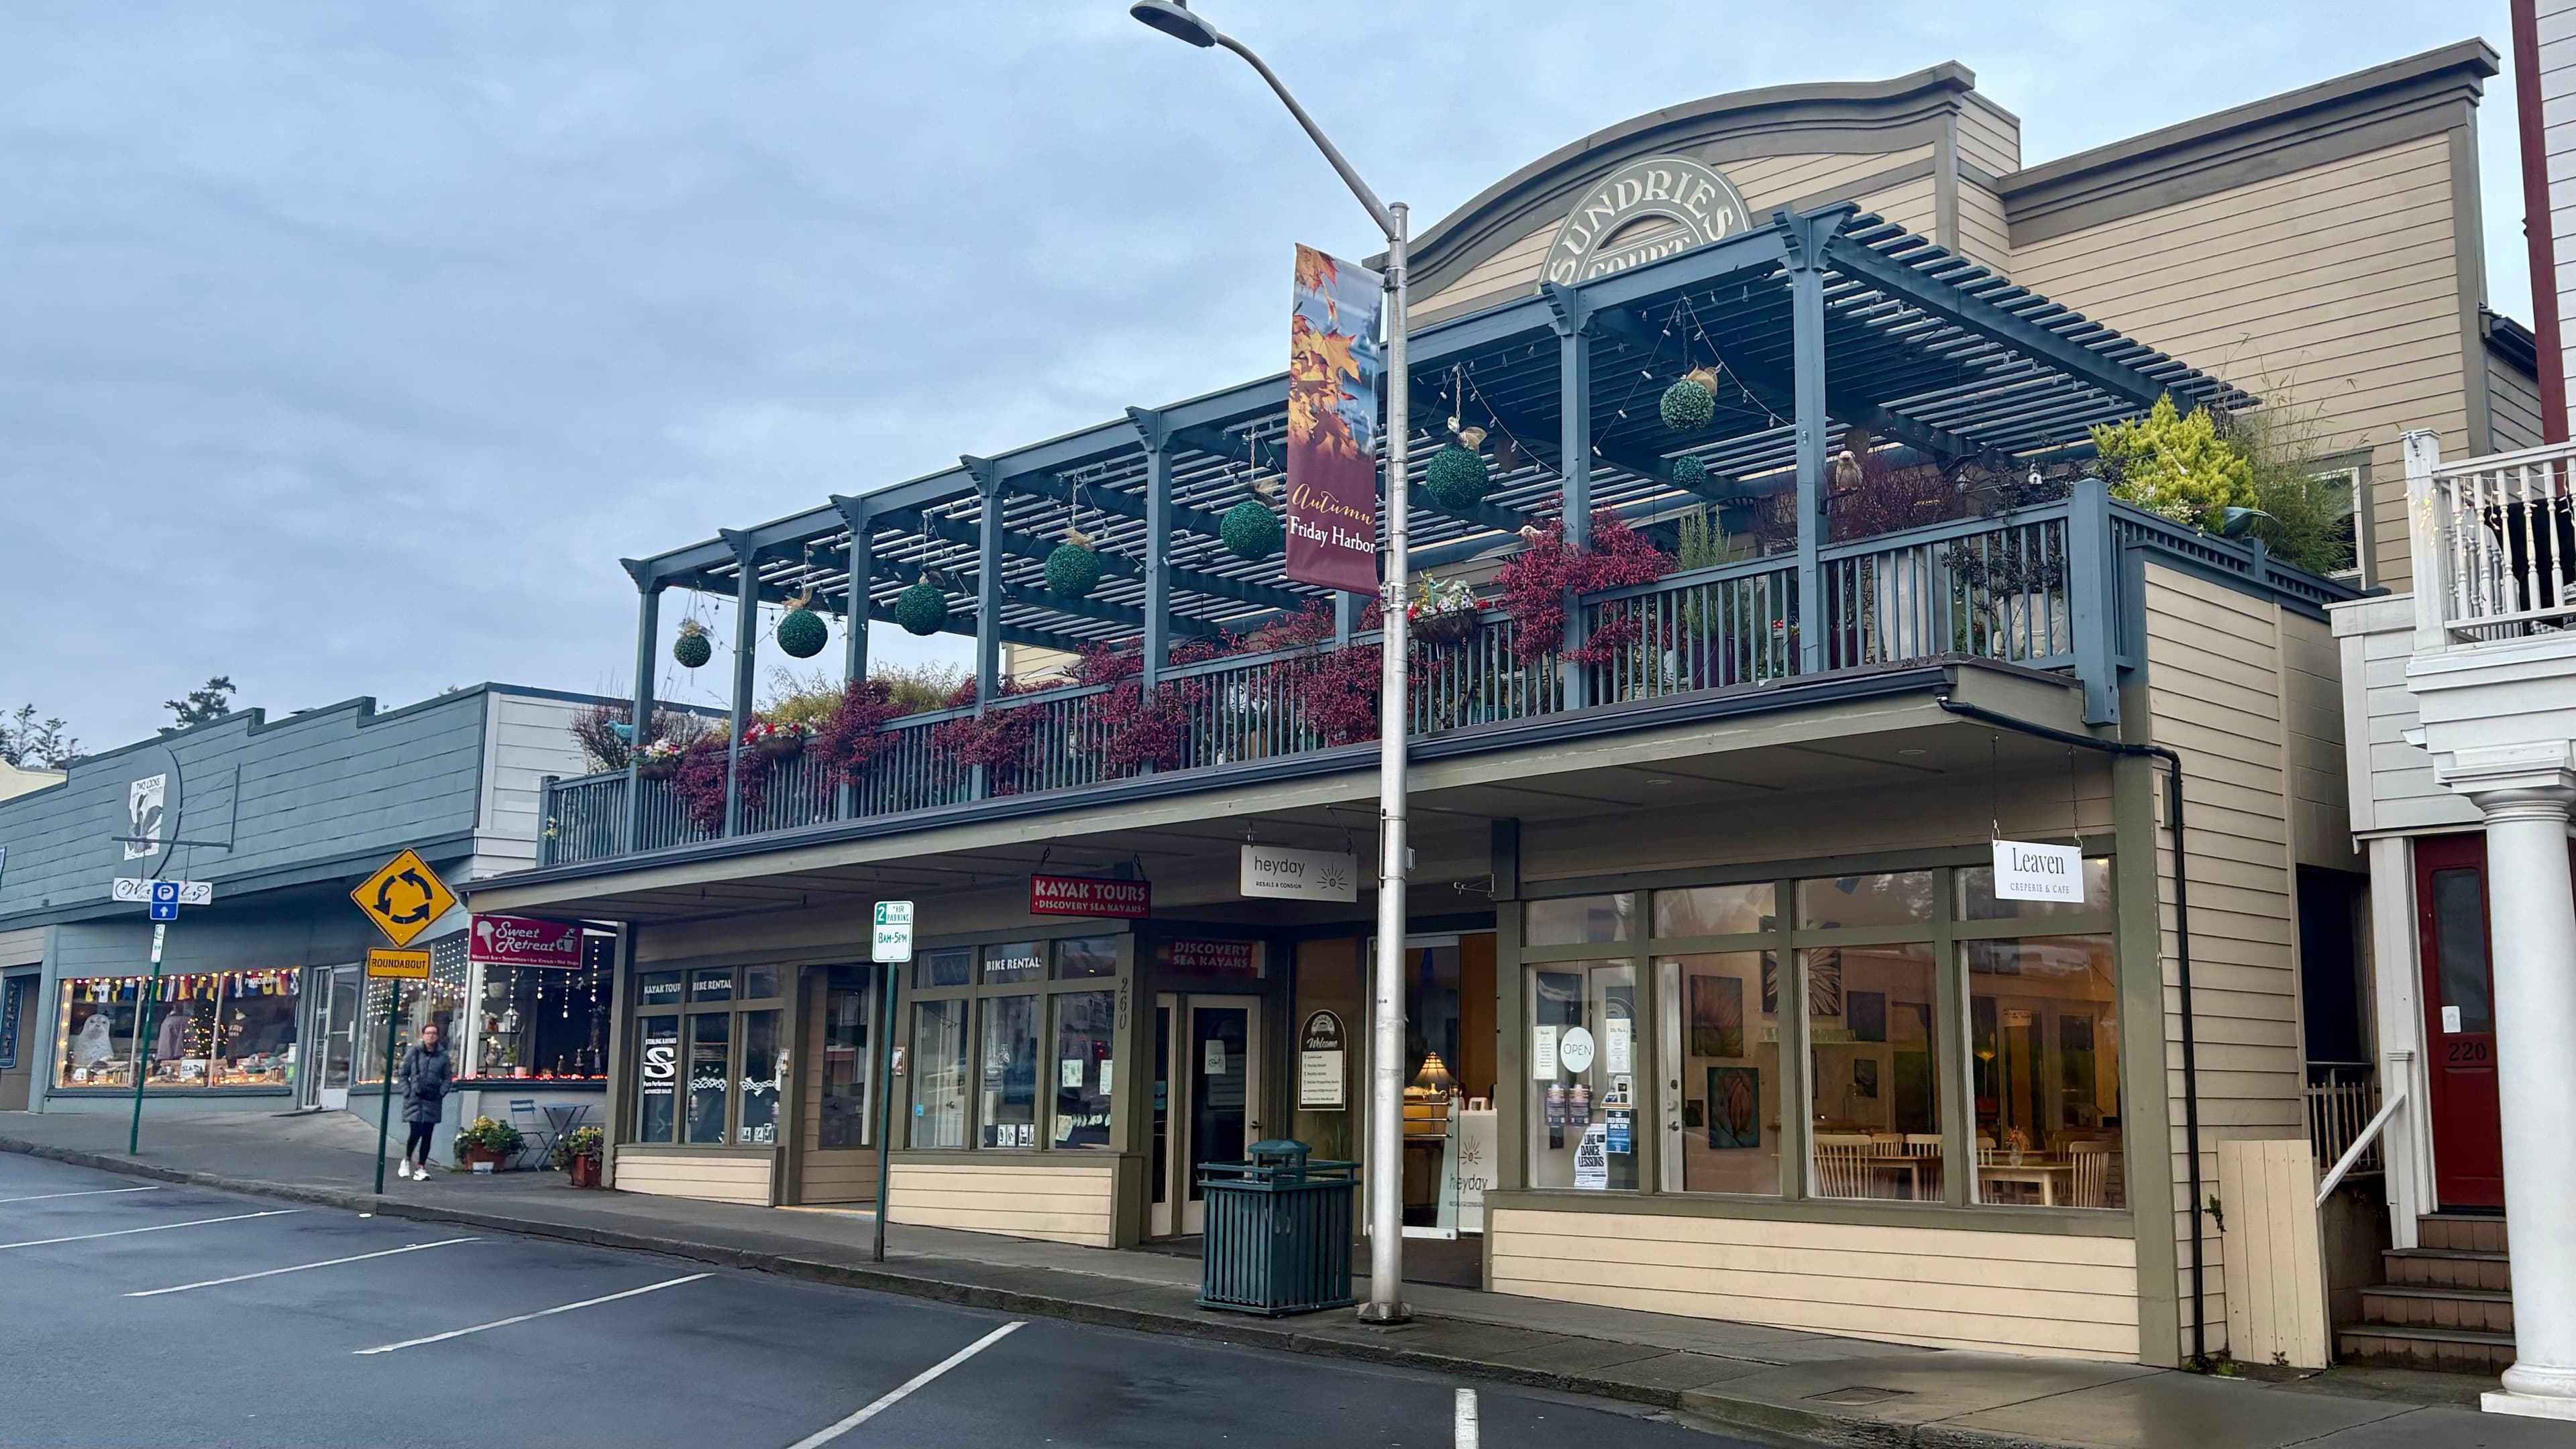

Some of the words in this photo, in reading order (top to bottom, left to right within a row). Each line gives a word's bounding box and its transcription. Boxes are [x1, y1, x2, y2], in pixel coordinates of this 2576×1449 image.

[1550, 170, 1733, 286] SUNDRIES
[1292, 484, 1374, 525] Autumn
[1289, 515, 1328, 547] Friday
[1332, 526, 1375, 553] Harbor
[1254, 855, 1305, 877] heyday
[2012, 847, 2065, 874] Leaven
[1035, 880, 1089, 898] KAYAK
[1094, 883, 1145, 902] TOURS
[2010, 882, 2043, 892] CREPERIE
[2053, 885, 2070, 894] CAFE
[1039, 900, 1087, 910] DISCOVERY
[1090, 903, 1106, 911] SEA
[1108, 904, 1142, 912] KAYAKS
[877, 906, 885, 922] 2
[495, 921, 539, 938] Sweet
[496, 938, 555, 953] Retreat
[1175, 942, 1249, 956] DISCOVERY
[372, 957, 425, 969] ROUNDABOUT
[986, 959, 1005, 971] BIKE
[1173, 954, 1195, 965] SEA
[1199, 956, 1248, 967] KAYAKS
[644, 984, 663, 995] KAYAK
[692, 981, 707, 991] BIKE
[1563, 1043, 1592, 1056] OPEN
[2448, 1041, 2487, 1061] 220
[1580, 1145, 1600, 1156] DANCE
[1578, 1157, 1605, 1167] LESSONS
